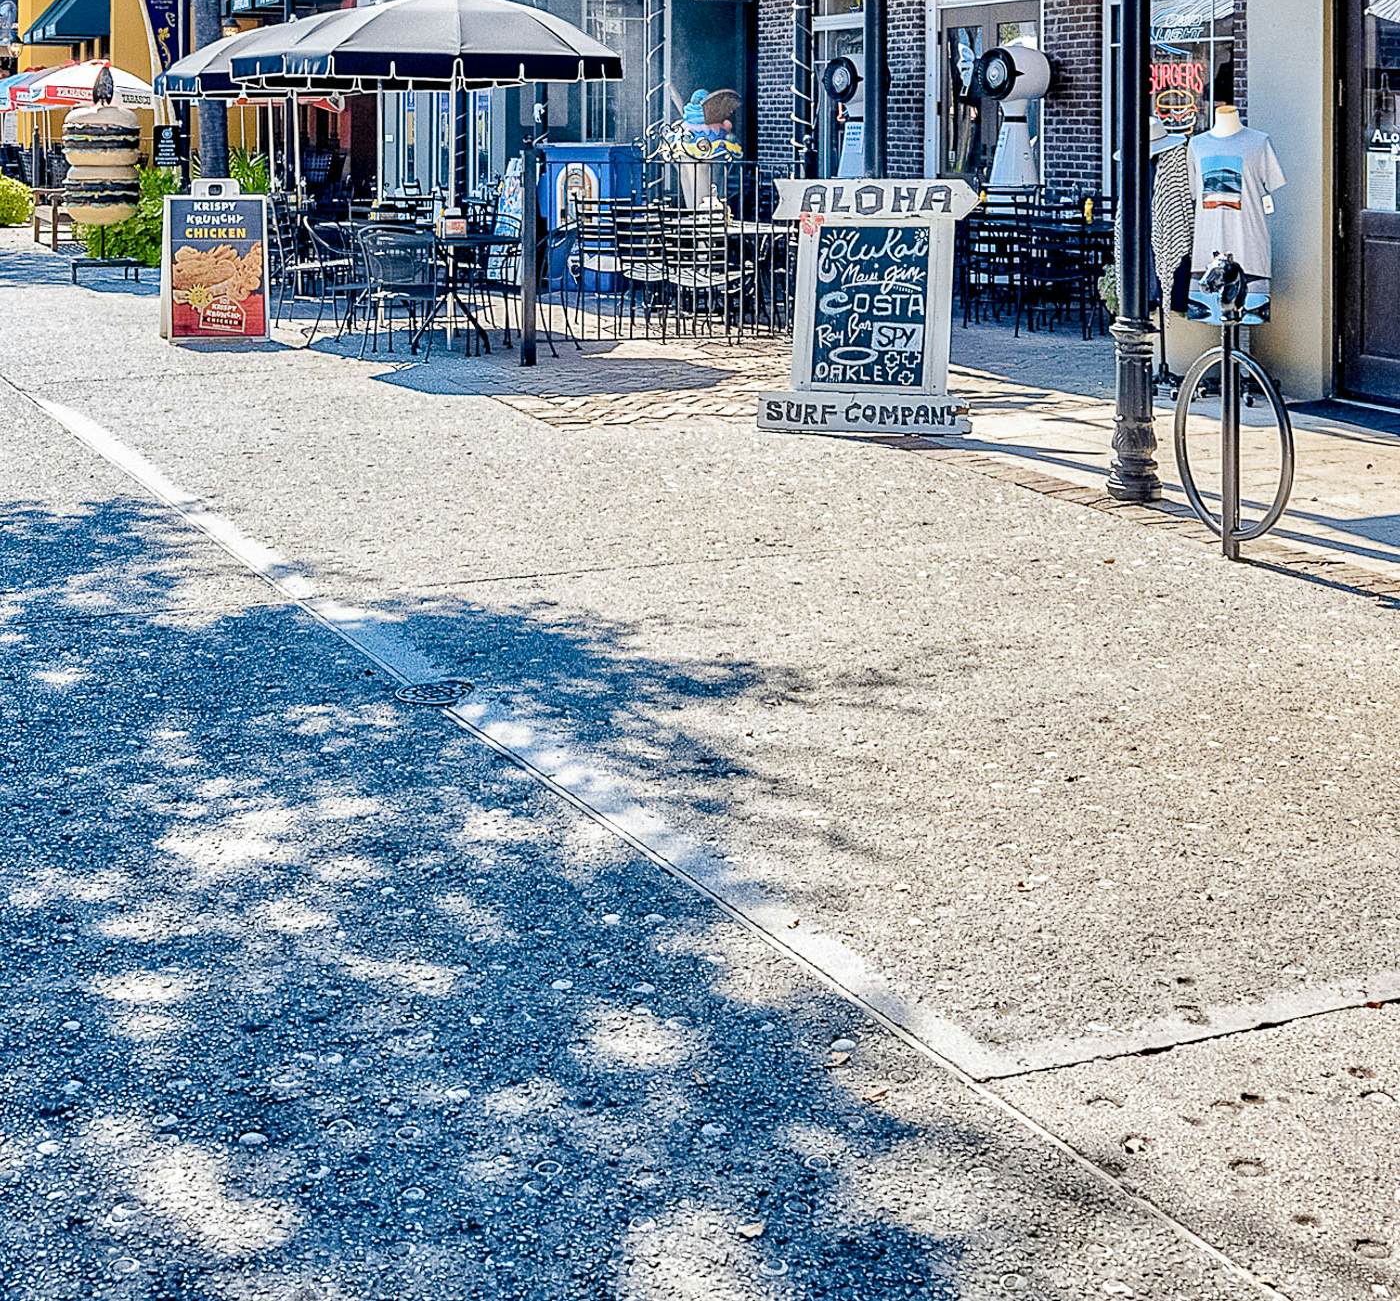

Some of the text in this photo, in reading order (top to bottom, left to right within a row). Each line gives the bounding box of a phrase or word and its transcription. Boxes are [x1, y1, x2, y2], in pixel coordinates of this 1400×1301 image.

[1155, 27, 1205, 42] LIGHT
[193, 202, 237, 211] KRISPY
[800, 184, 953, 216] ALOHA
[186, 214, 244, 225] KRUNCHY
[185, 228, 246, 238] CHICKEN
[819, 290, 925, 317] COSTA
[876, 325, 916, 348] SPY
[814, 361, 900, 383] OAKLEY
[766, 399, 960, 427] SURF COMPANY
